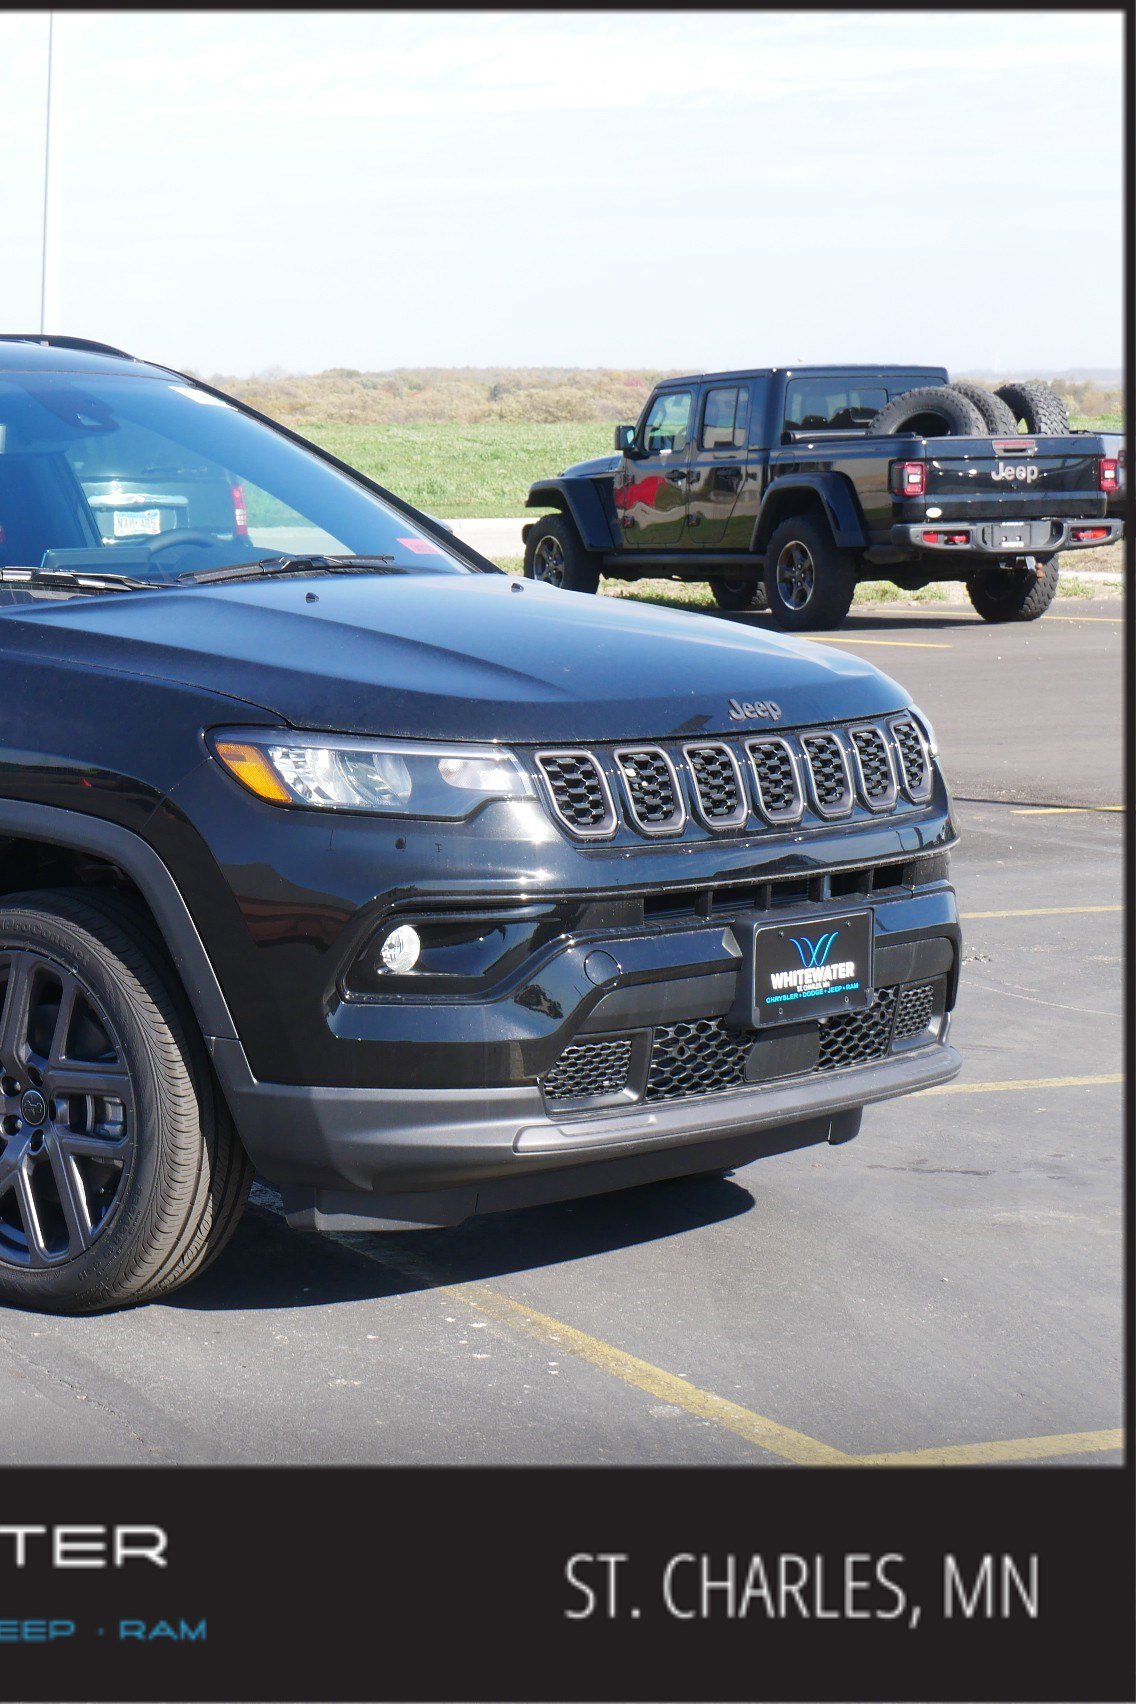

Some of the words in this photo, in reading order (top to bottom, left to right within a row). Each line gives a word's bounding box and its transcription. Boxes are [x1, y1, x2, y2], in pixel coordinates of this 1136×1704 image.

[991, 462, 1038, 484] Jeep
[728, 698, 782, 721] Jeep
[770, 961, 856, 990] WHITEWATER
[765, 992, 799, 1004] CHRYSLER
[802, 988, 824, 998] DODGE
[827, 985, 842, 994] JEEP
[845, 982, 859, 990] RAM
